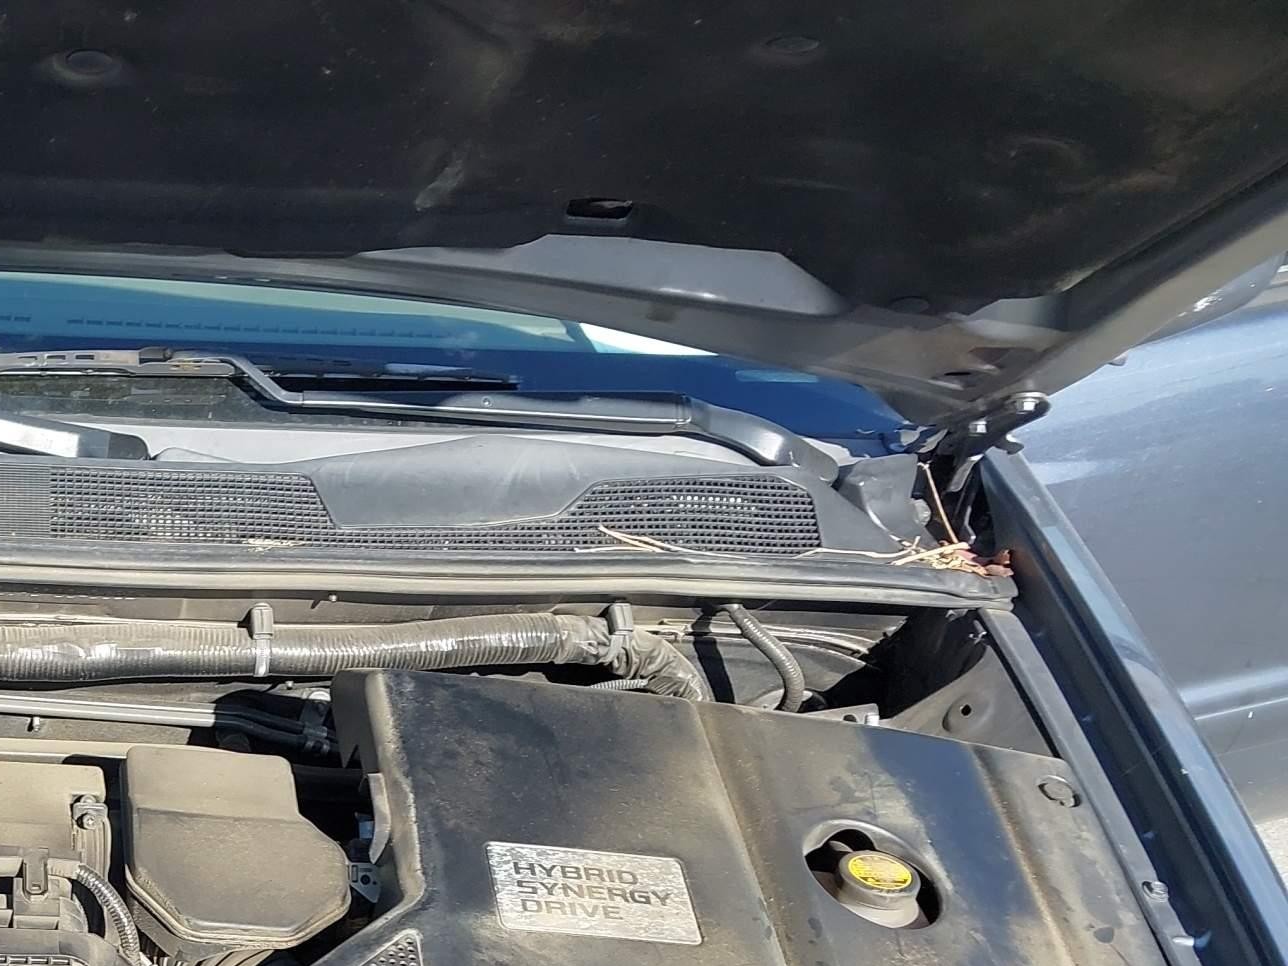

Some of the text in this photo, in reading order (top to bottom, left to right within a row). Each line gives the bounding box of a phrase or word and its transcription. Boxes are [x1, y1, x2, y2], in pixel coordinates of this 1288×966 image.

[512, 861, 639, 885] HYBRID
[516, 879, 673, 906] SYNERGY
[520, 899, 623, 920] DRIVE
